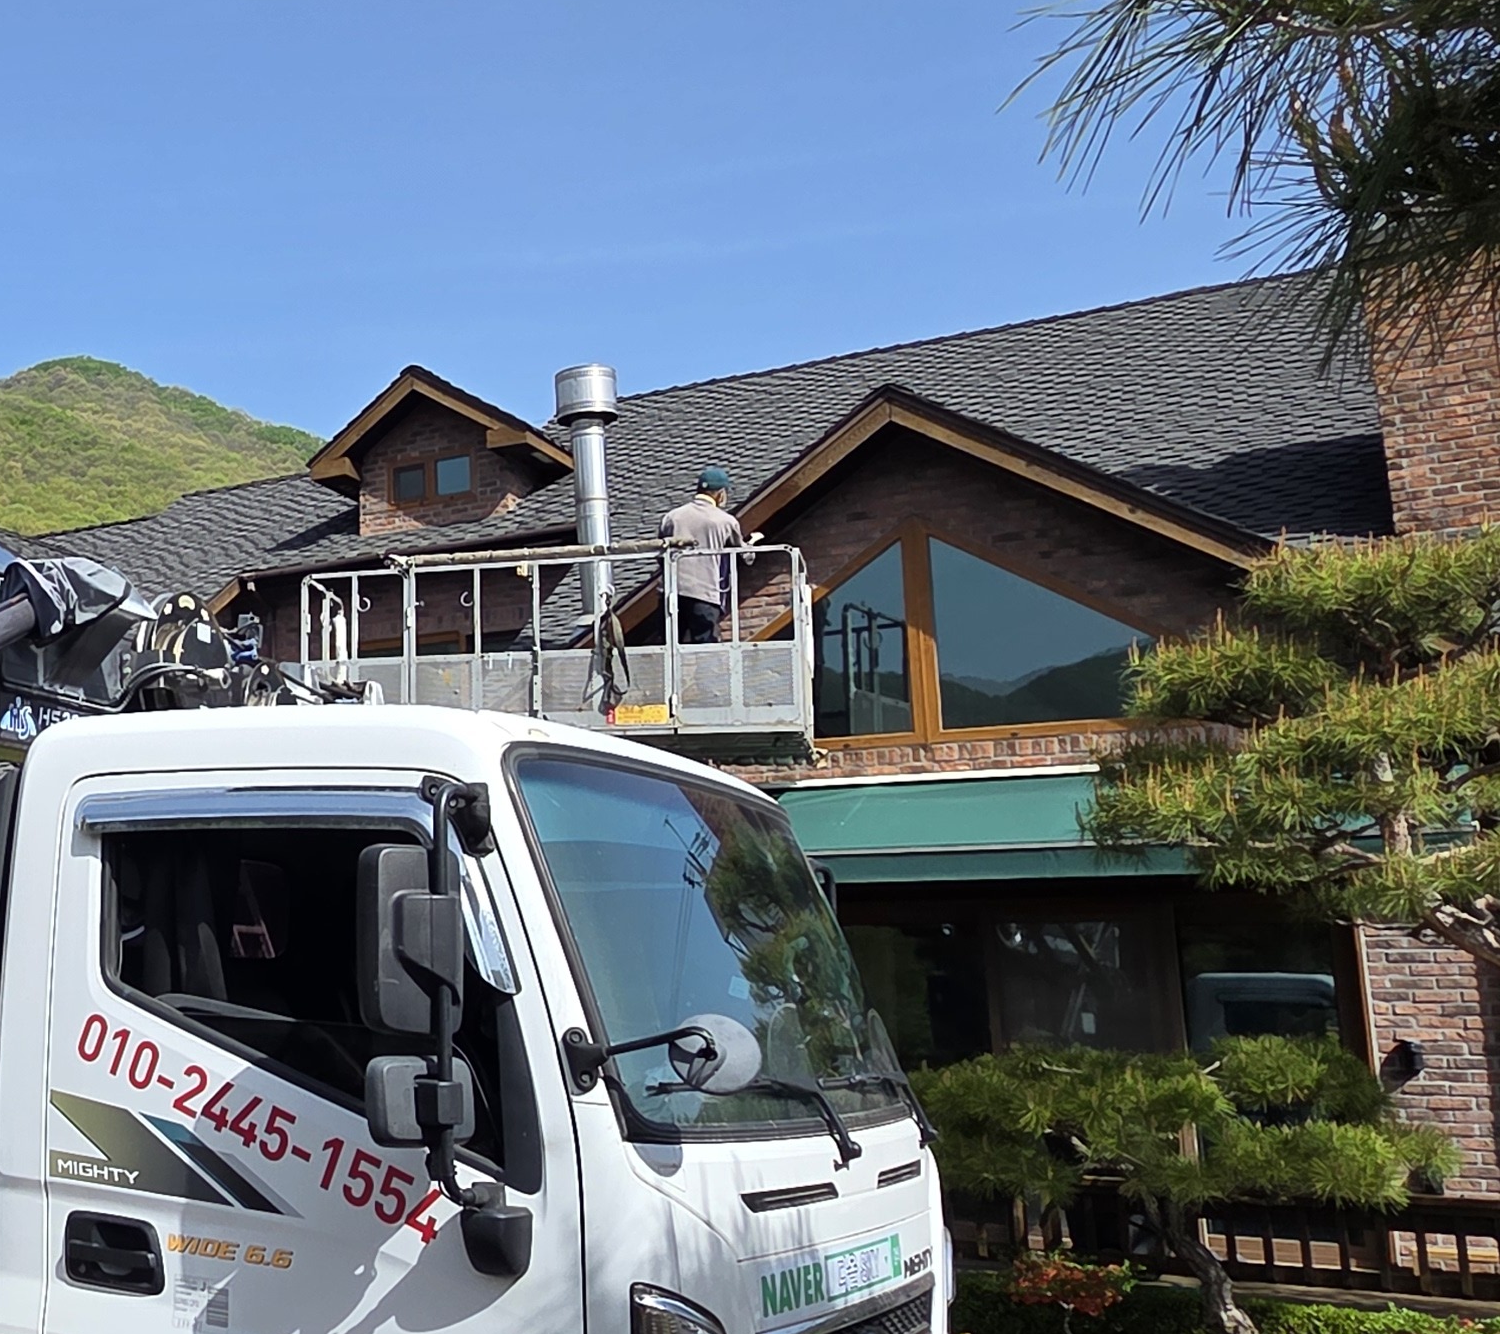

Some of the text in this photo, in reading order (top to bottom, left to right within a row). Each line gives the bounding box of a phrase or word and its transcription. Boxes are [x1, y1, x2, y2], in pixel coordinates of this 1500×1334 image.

[77, 1013, 442, 1245] 010-2445-1554
[56, 1158, 140, 1185] MIGHTY
[166, 1233, 294, 1270] WIDE 6.6
[760, 1262, 825, 1318] NAVER
